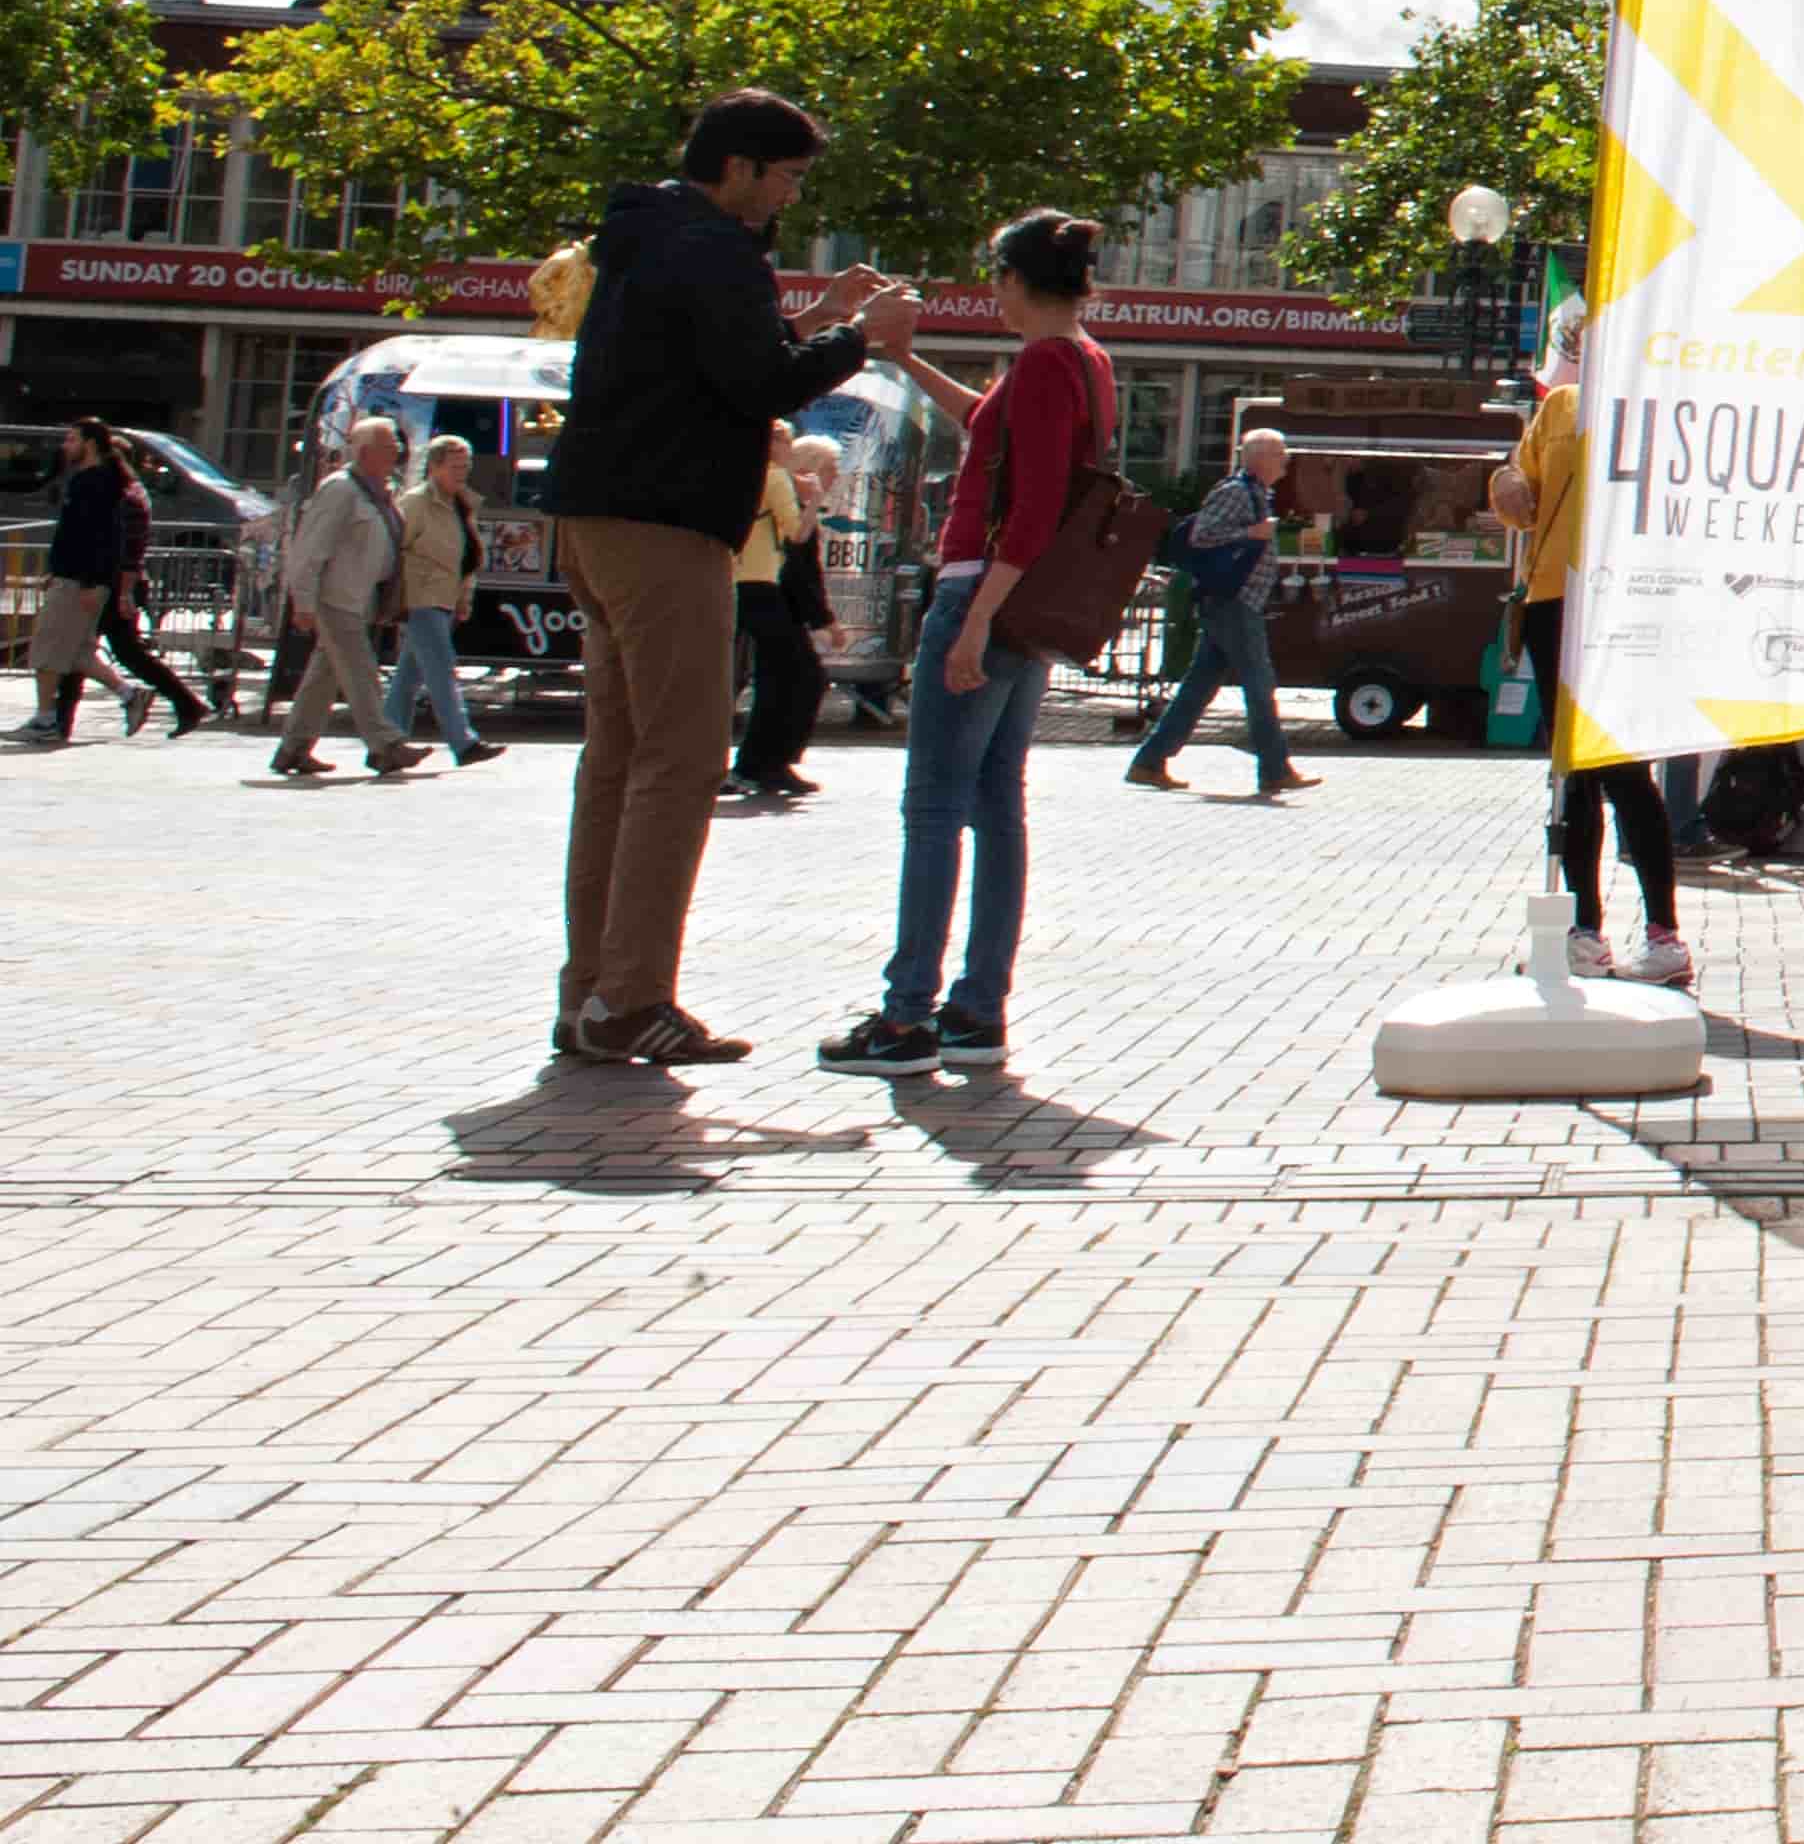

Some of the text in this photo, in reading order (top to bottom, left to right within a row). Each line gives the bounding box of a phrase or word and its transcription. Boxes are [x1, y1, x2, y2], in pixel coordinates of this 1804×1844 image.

[60, 259, 180, 285] SUNDAY
[188, 265, 226, 287] 20
[235, 266, 366, 293] OCTOBE
[915, 296, 1003, 317] MARAT
[1607, 397, 1658, 535] 4
